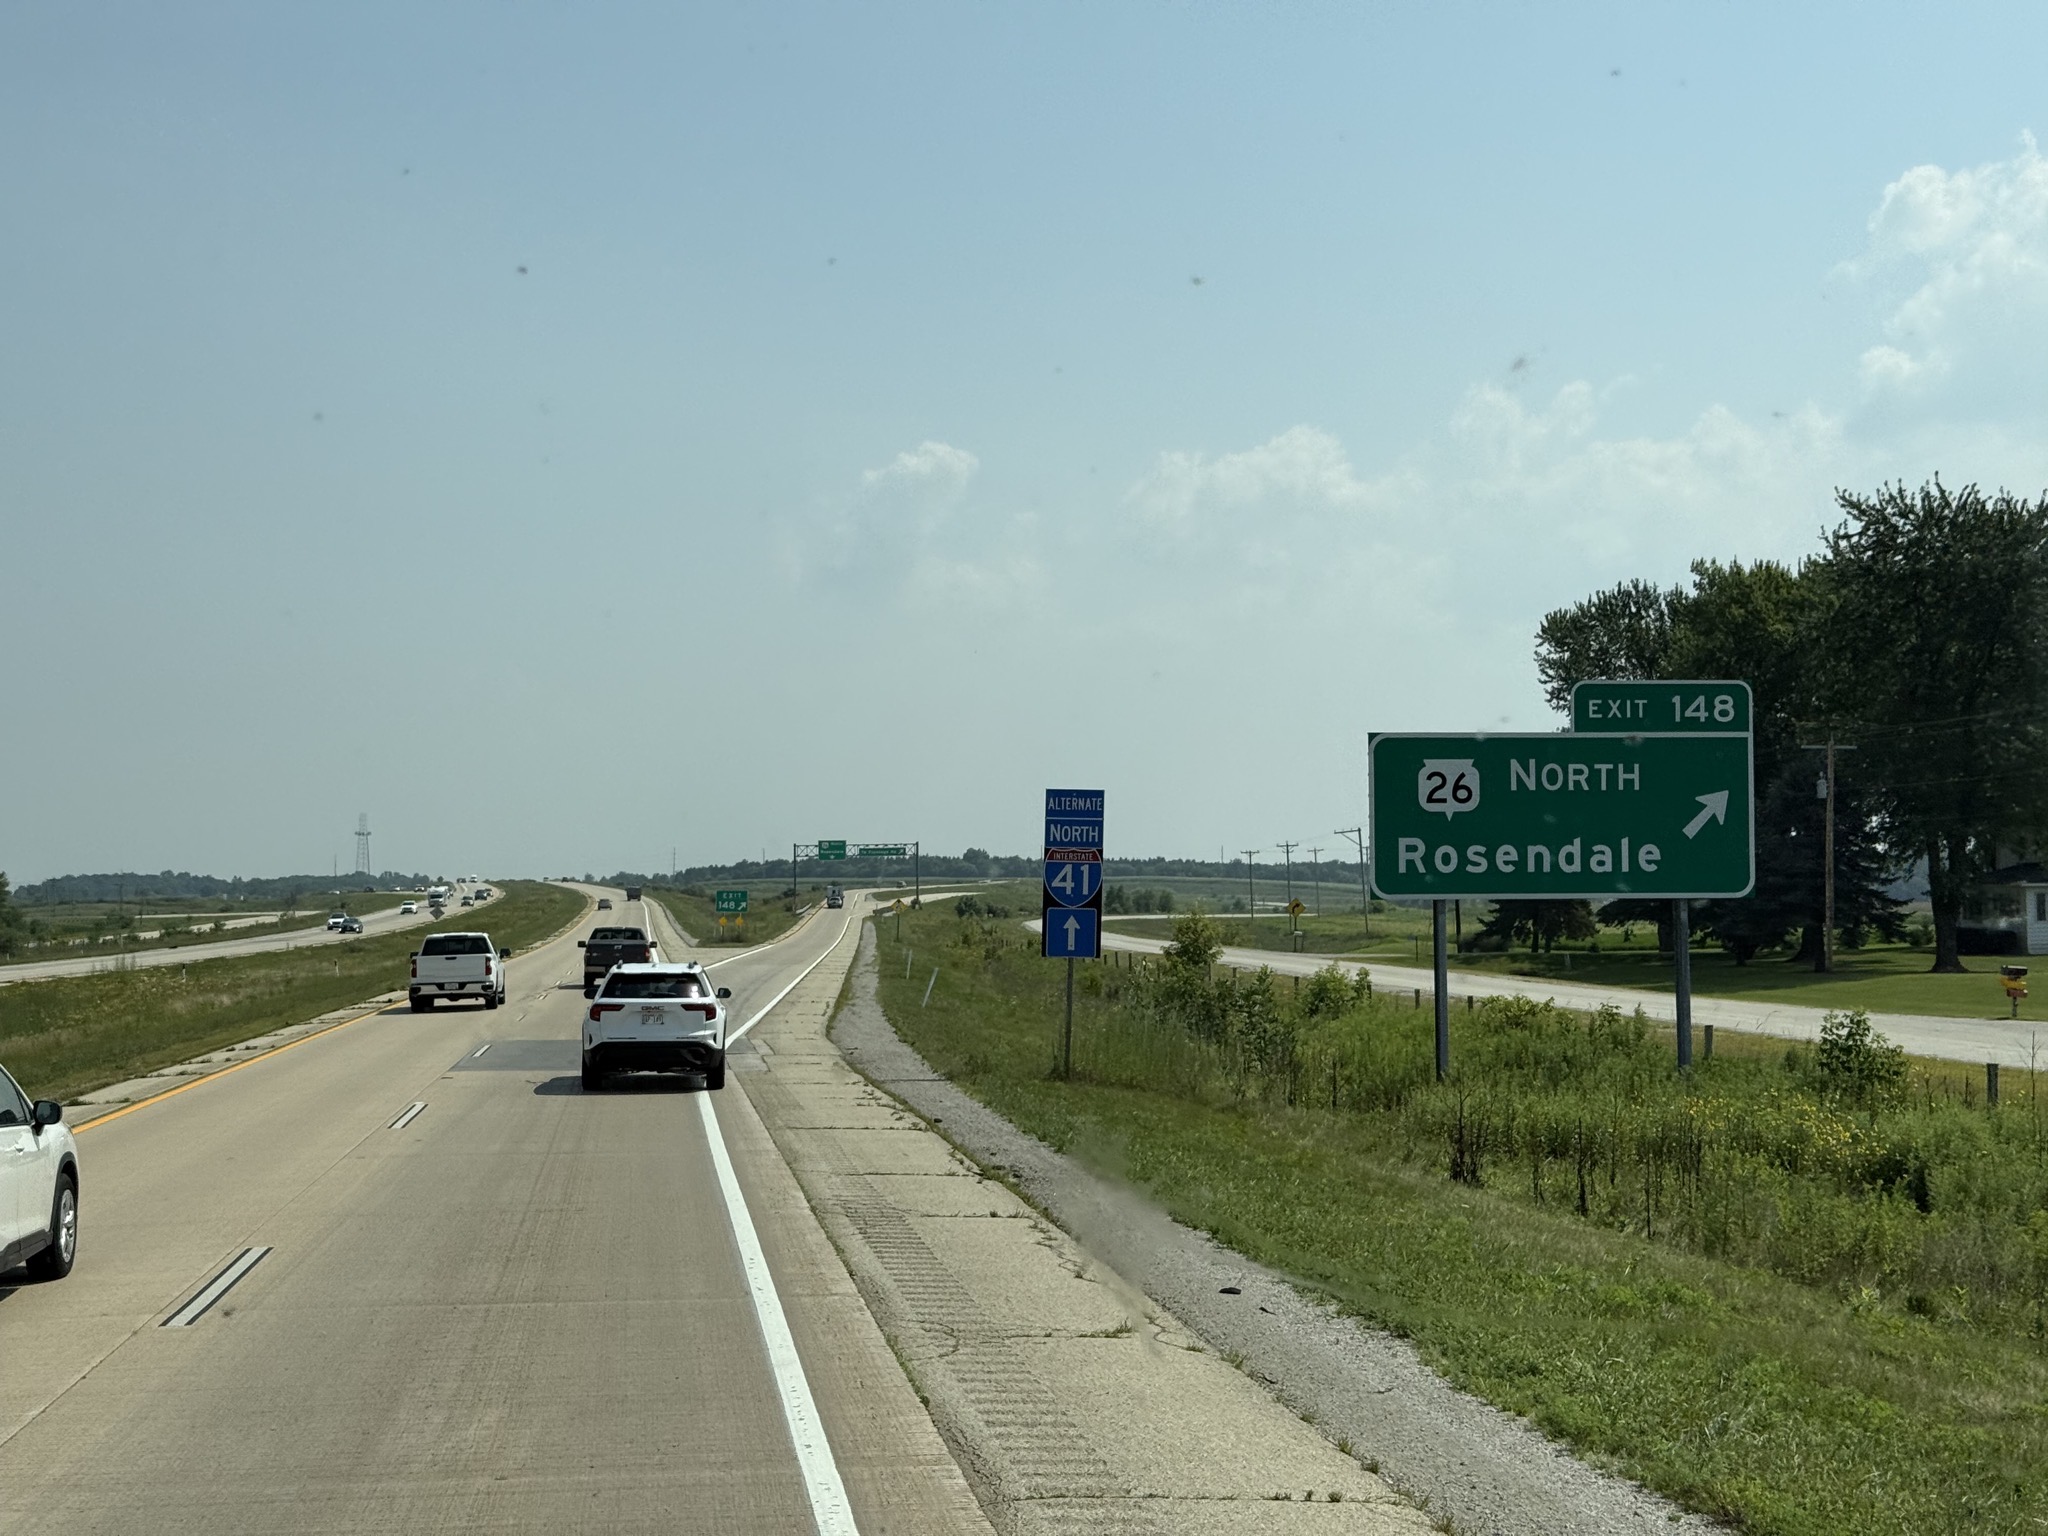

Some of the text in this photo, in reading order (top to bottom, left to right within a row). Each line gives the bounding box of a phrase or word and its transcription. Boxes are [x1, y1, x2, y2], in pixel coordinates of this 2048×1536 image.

[1588, 695, 1735, 723] EXIT 148
[1425, 771, 1473, 804] 26
[1510, 758, 1640, 791] NORTH
[1048, 797, 1103, 811] ALTERNATE
[1050, 823, 1099, 843] NORTH
[1053, 852, 1094, 861] INTERSTATE
[1398, 836, 1662, 874] Rosendale
[1051, 863, 1089, 896] 41
[718, 901, 735, 910] 148
